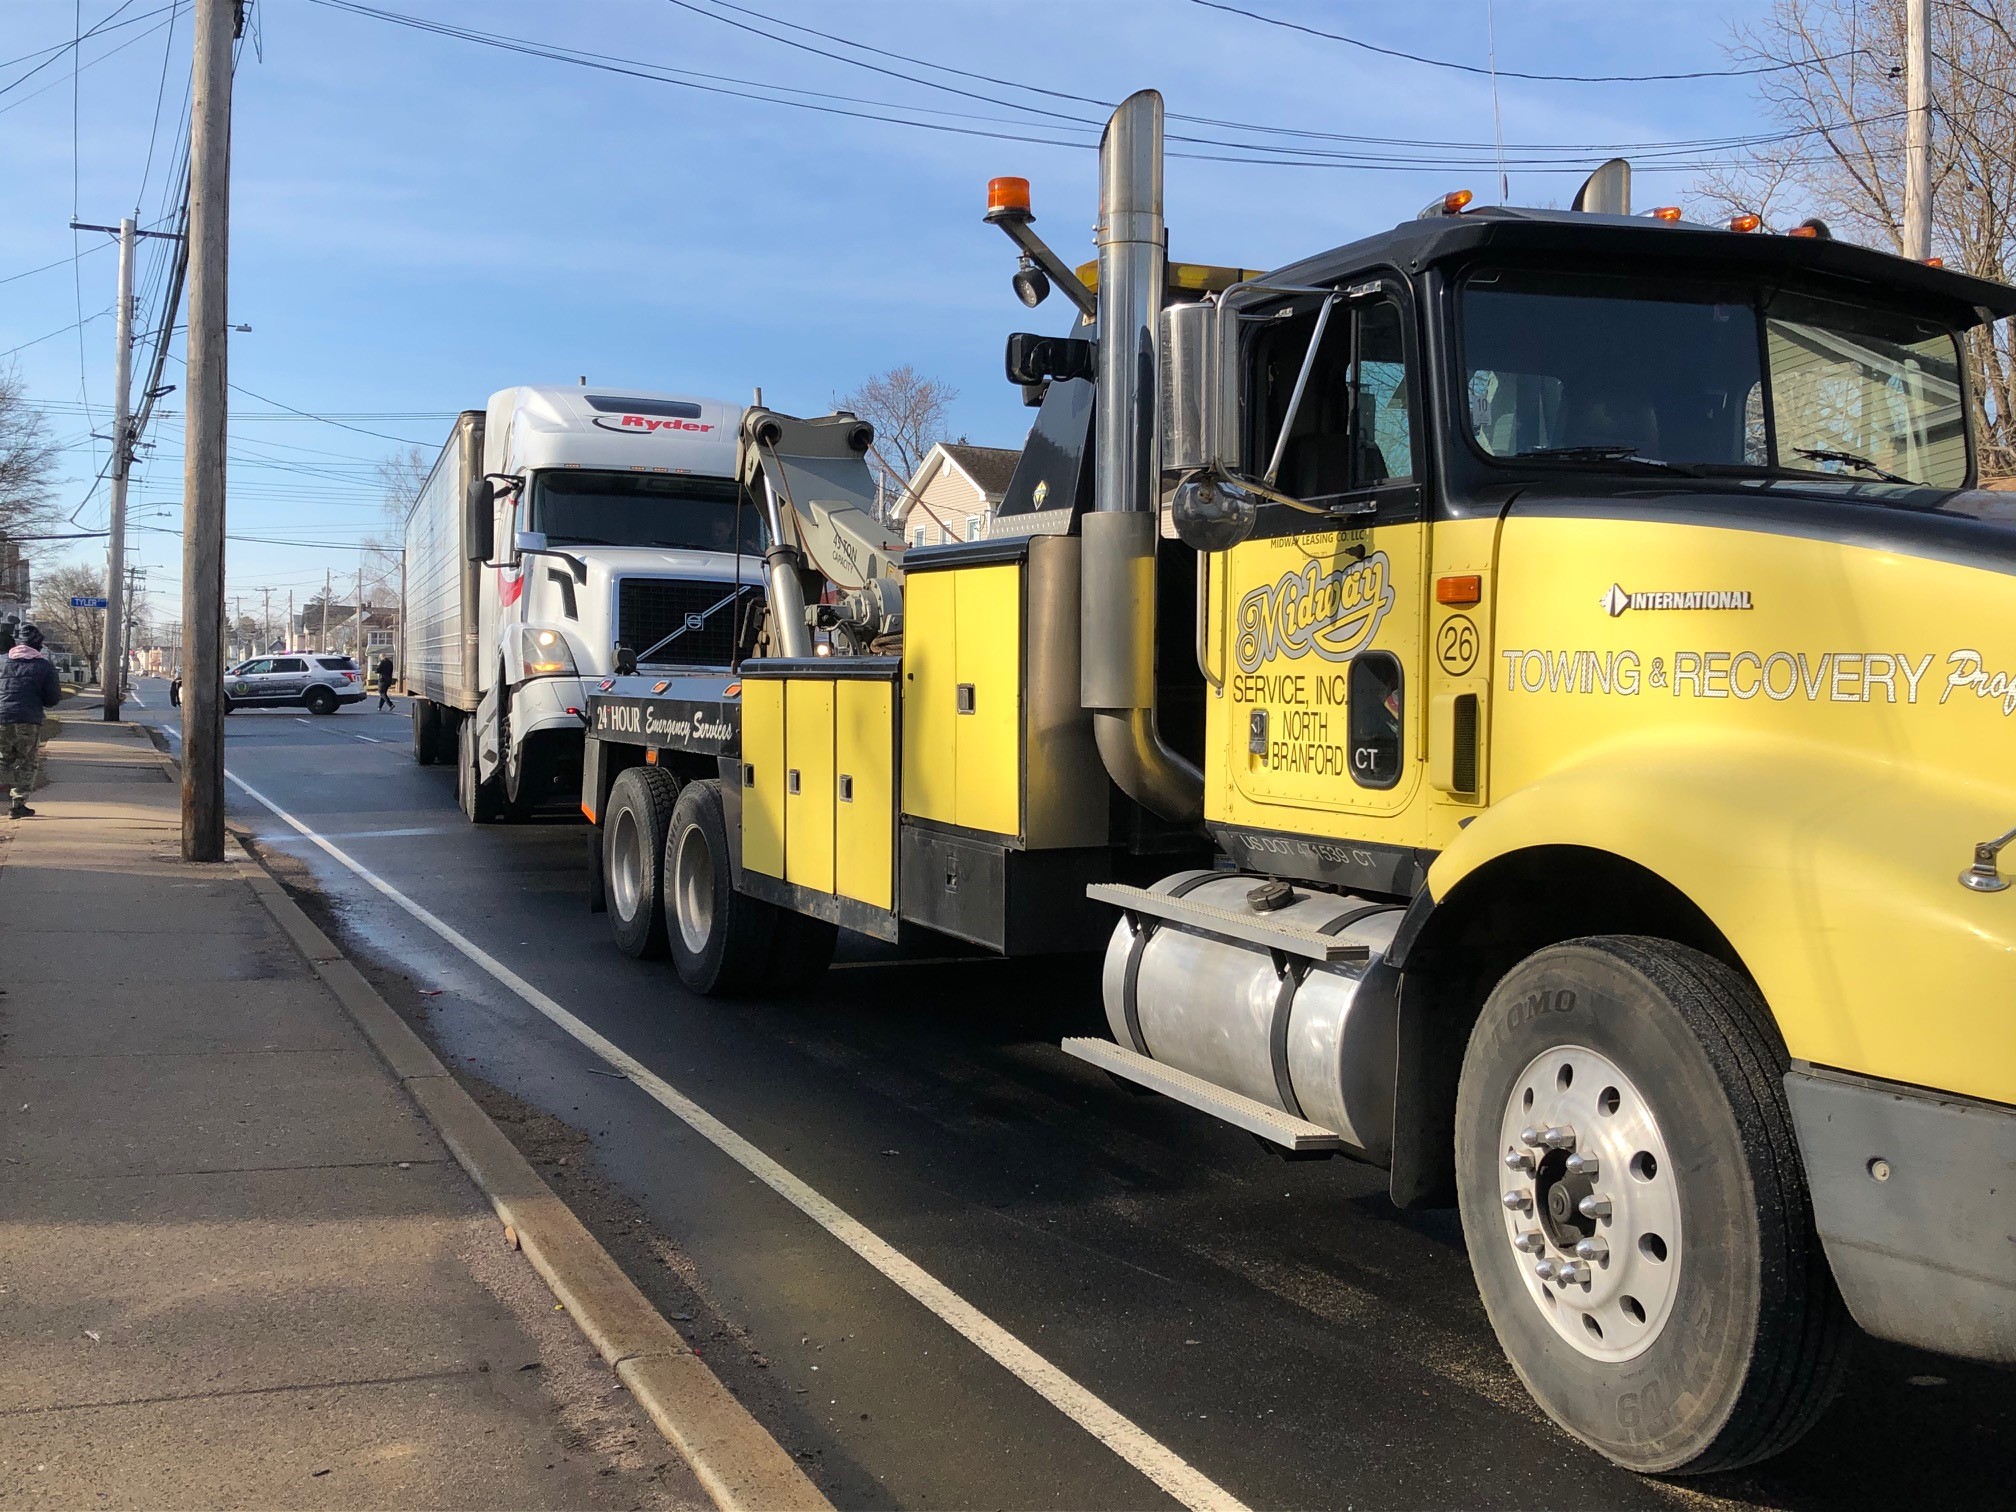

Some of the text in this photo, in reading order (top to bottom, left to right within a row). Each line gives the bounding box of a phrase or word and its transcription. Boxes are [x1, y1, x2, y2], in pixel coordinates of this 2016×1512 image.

[621, 415, 715, 433] Ryder
[843, 539, 858, 562] TON
[1270, 529, 1365, 549] MIDWAY LEASING CO. LLC
[832, 550, 854, 574] CAPACITY
[74, 598, 97, 607] TYLER
[1239, 561, 1388, 666] Midway
[1630, 591, 1753, 609] INTERNATIONAL
[1444, 626, 1473, 662] 26
[1233, 674, 1309, 710] SERVICE,
[1501, 649, 1642, 696] TOWING
[1648, 656, 1669, 689] &
[1673, 651, 1936, 705] RECOVERY
[597, 704, 733, 746] 24 HOUR Emergency Services
[1282, 710, 1328, 743] NORTH
[1272, 741, 1379, 776] BRANFORD CT
[1239, 834, 1377, 867] US DOT 471539 CT
